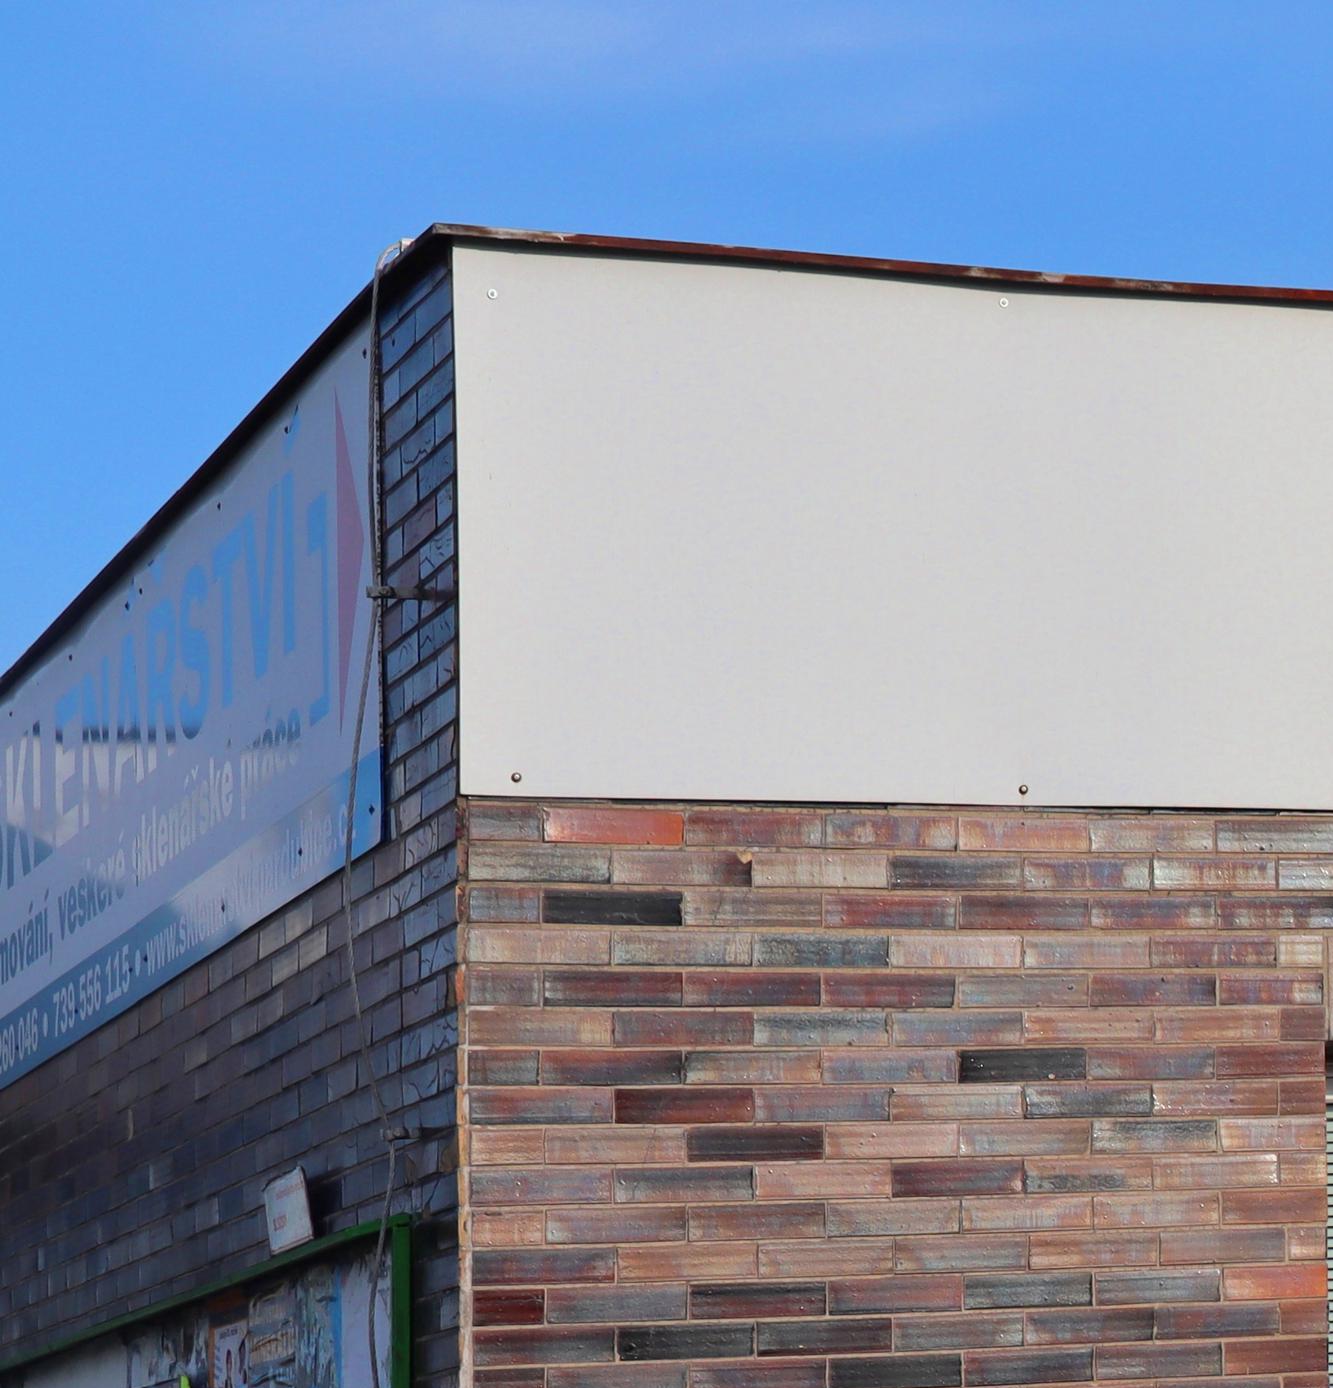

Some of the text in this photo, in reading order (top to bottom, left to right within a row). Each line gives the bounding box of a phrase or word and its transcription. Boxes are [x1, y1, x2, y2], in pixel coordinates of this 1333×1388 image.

[0, 407, 295, 892] KLENÁŘSTVÍ
[53, 982, 75, 1038] 739
[79, 964, 102, 1022] 556
[105, 943, 131, 1004] 115
[146, 801, 356, 977] www.sklenarstvipardubice.c
